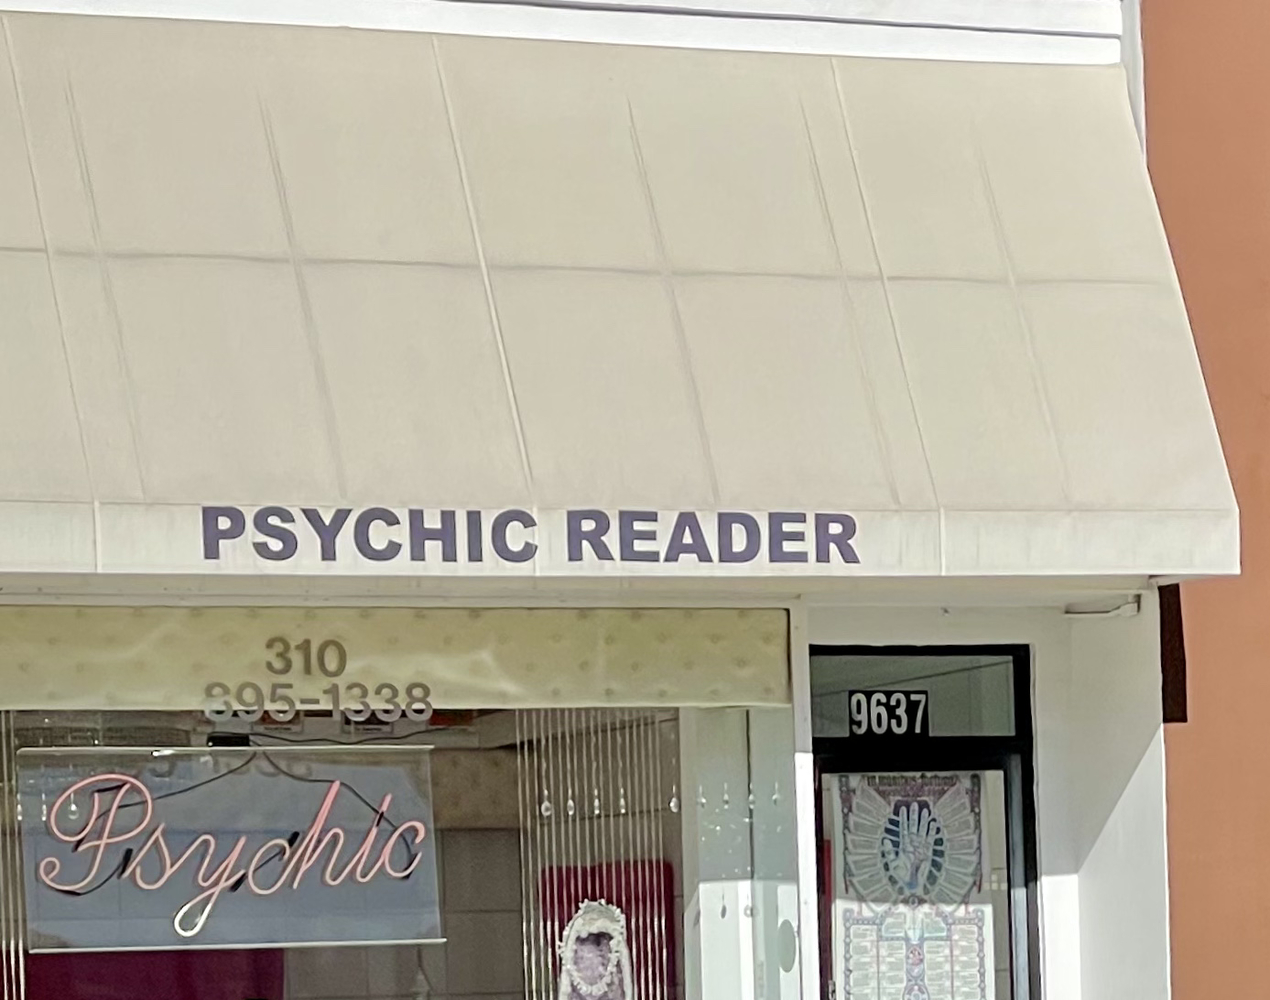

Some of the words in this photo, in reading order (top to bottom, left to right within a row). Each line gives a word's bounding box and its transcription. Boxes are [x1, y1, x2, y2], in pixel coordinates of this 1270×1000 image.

[201, 505, 538, 564] PSYCHIC
[566, 508, 861, 565] READER
[264, 636, 347, 678] 310
[204, 681, 433, 723] 895-1338
[850, 692, 927, 735] 9637
[38, 772, 427, 940] Psychic
